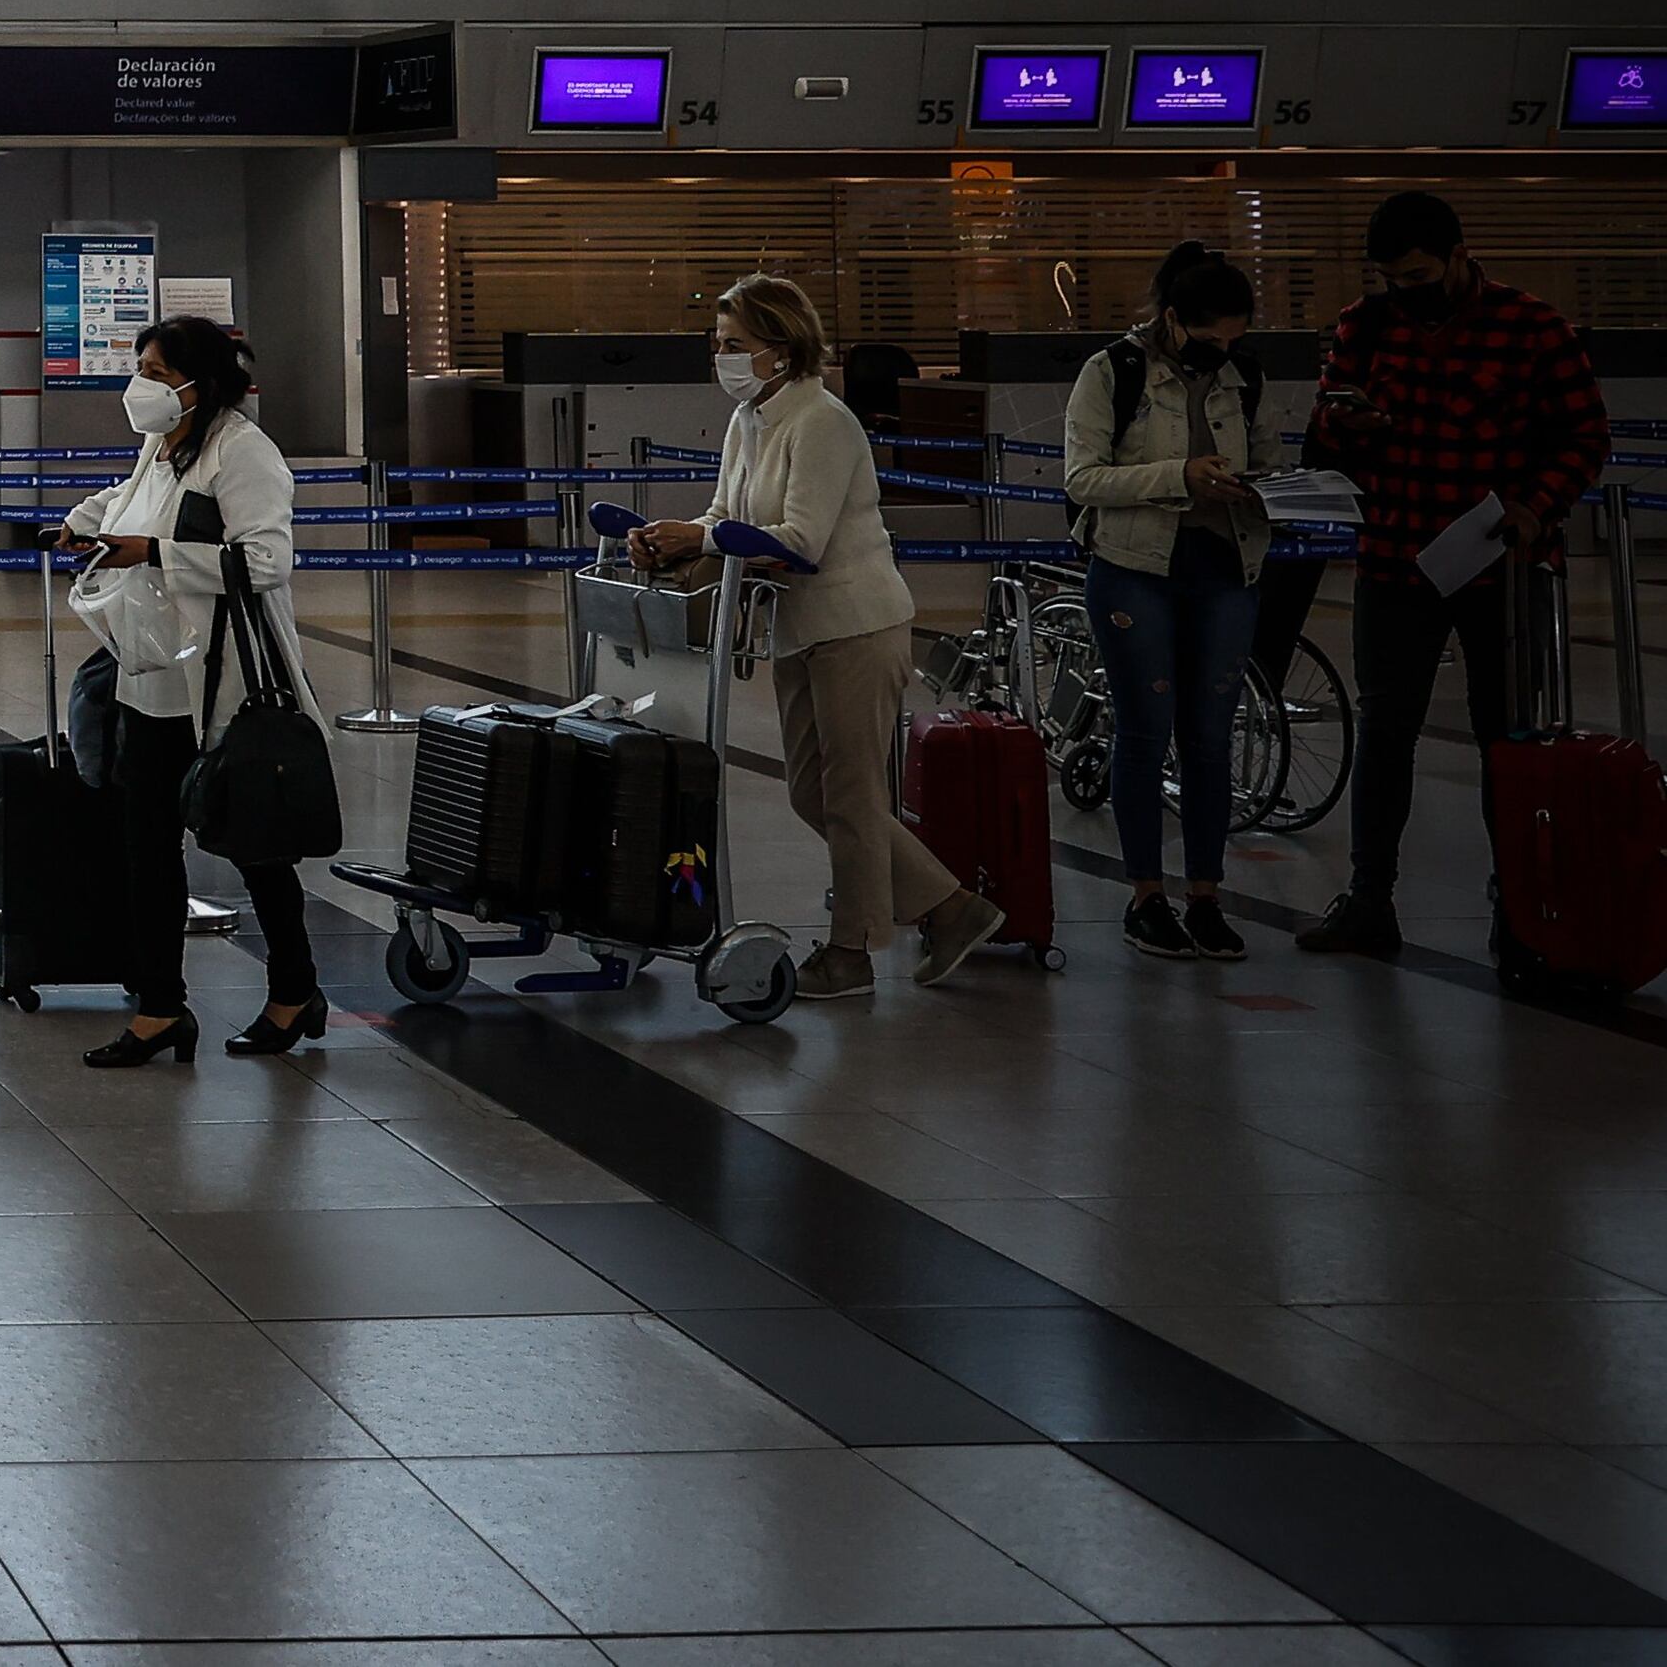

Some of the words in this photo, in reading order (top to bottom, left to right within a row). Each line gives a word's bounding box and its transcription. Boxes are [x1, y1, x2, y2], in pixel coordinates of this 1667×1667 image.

[117, 57, 216, 72] Declaración
[117, 74, 138, 88] de
[142, 74, 203, 88] valores
[114, 97, 164, 109] Declared
[166, 97, 195, 109] value
[918, 100, 955, 125] 55
[1274, 100, 1312, 125] 56
[181, 112, 195, 125] de
[197, 112, 236, 125] valores
[678, 101, 719, 125] 54
[1508, 101, 1547, 125] 57
